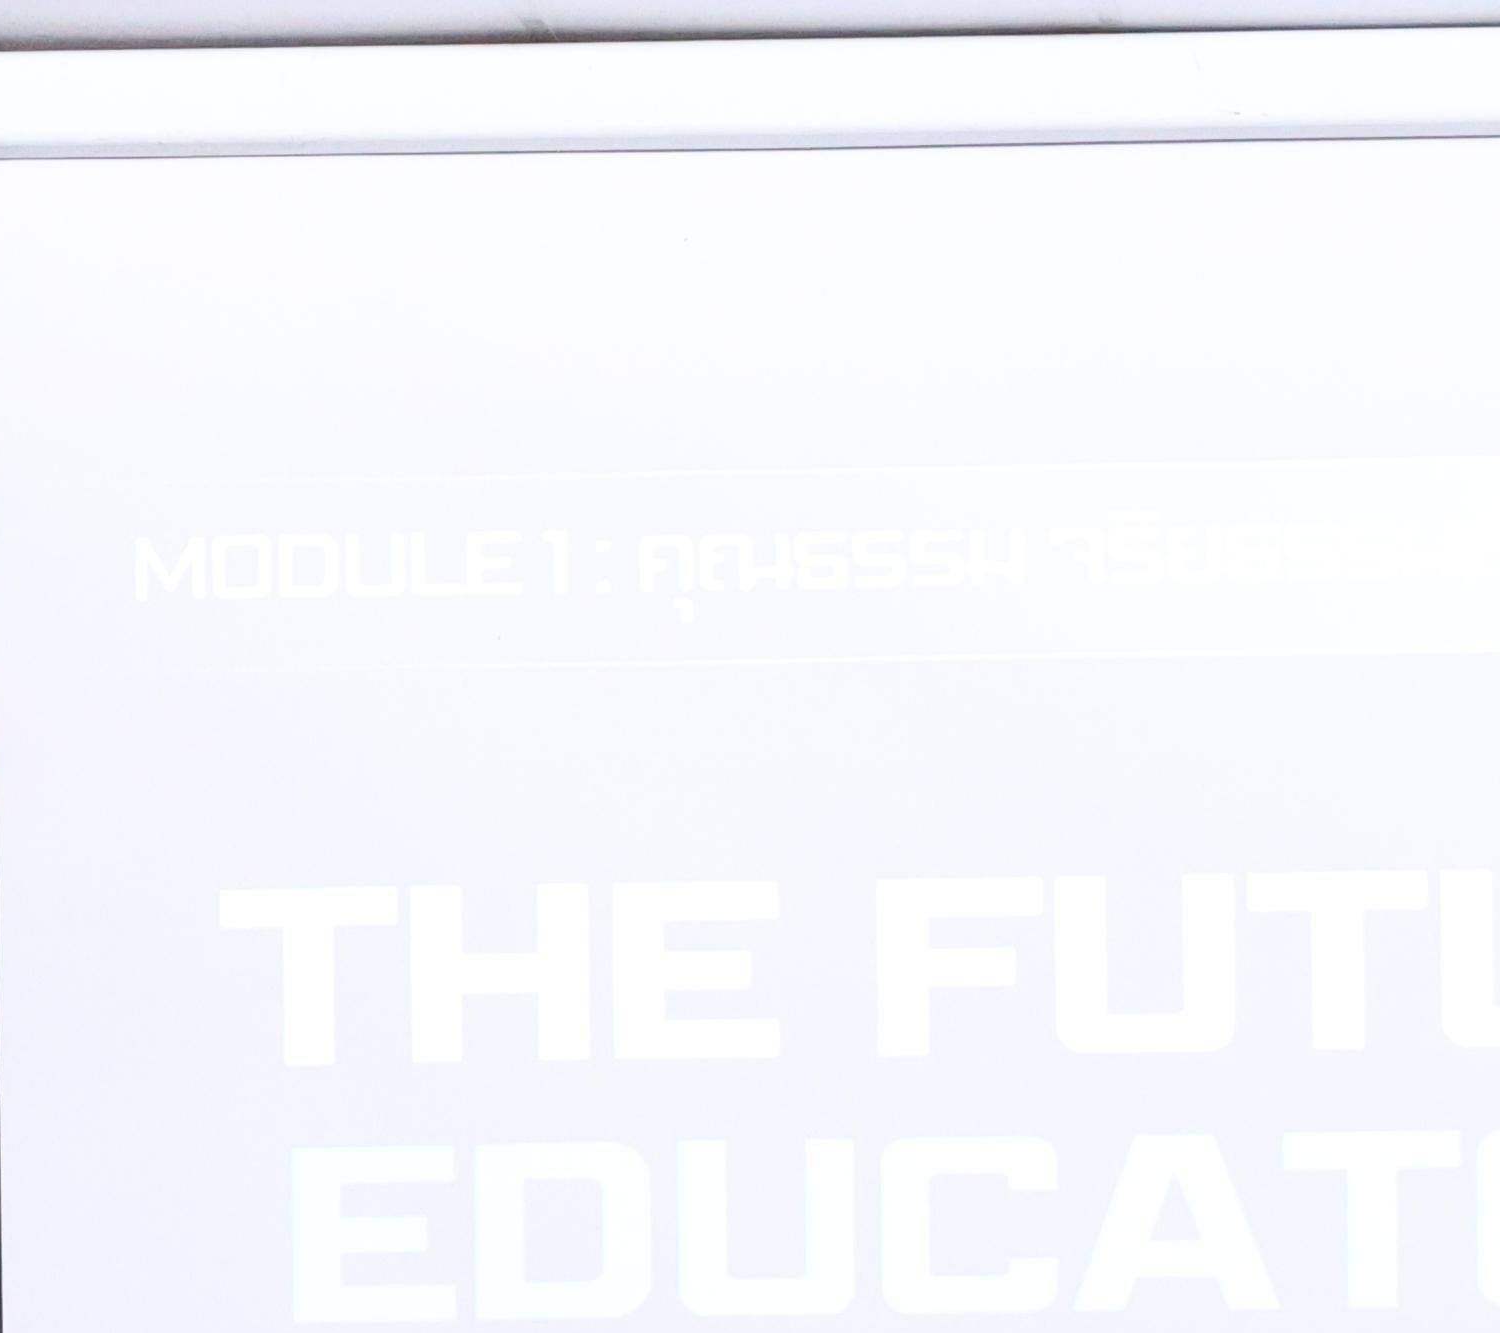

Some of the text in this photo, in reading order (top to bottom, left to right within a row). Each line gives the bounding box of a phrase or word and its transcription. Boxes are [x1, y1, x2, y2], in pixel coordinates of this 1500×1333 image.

[133, 530, 524, 602] MODULE
[541, 528, 569, 595] 1
[637, 527, 1028, 622] คุณธรรม
[218, 880, 781, 1066] THE
